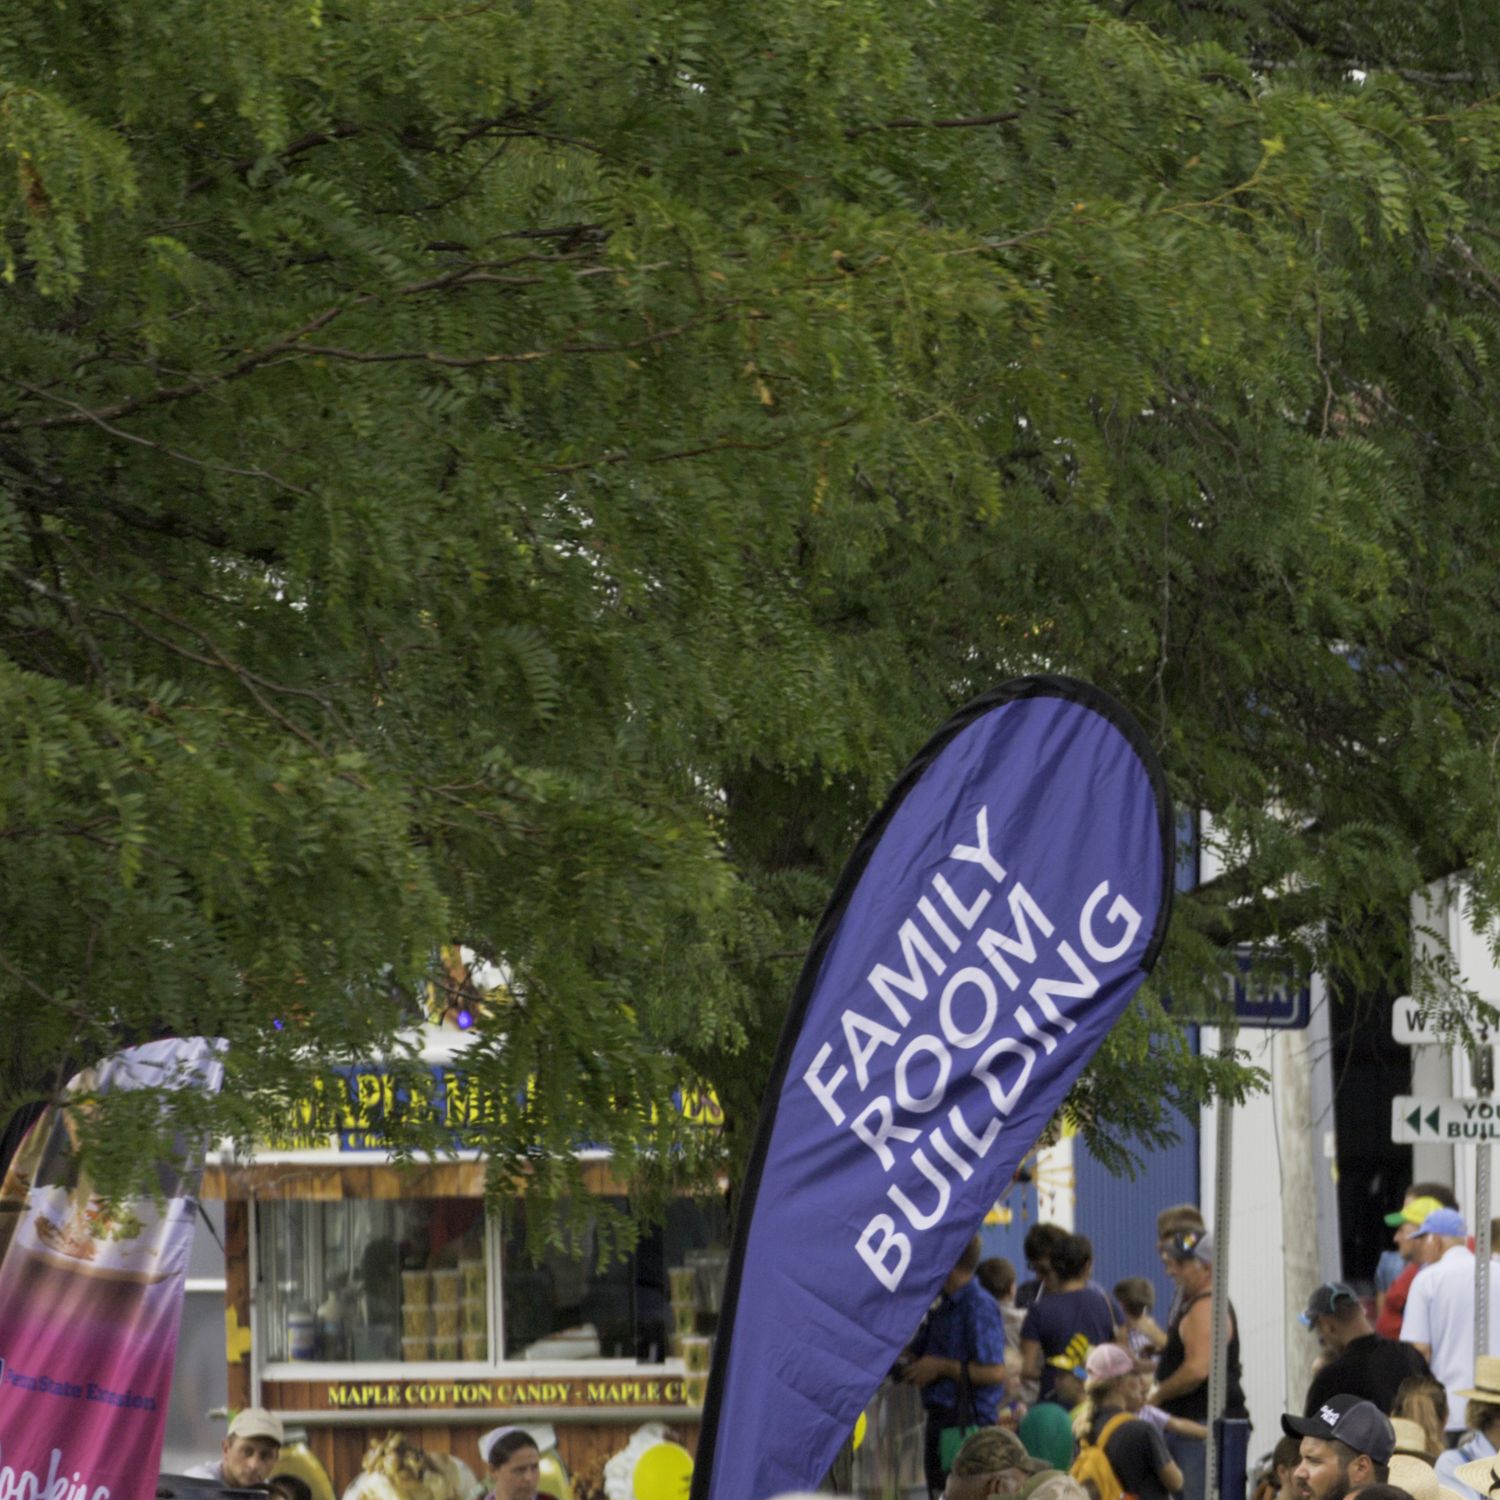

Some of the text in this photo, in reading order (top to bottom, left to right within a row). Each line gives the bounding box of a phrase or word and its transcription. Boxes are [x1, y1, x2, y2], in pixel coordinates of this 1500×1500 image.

[803, 805, 1007, 1126] FAMILY
[851, 881, 1055, 1172] ROOM
[854, 880, 1143, 1292] BUILDING
[327, 1385, 400, 1406] MAPLE
[404, 1383, 493, 1405] COTTON
[497, 1382, 571, 1404] CANDY
[587, 1381, 661, 1402] MAPLE
